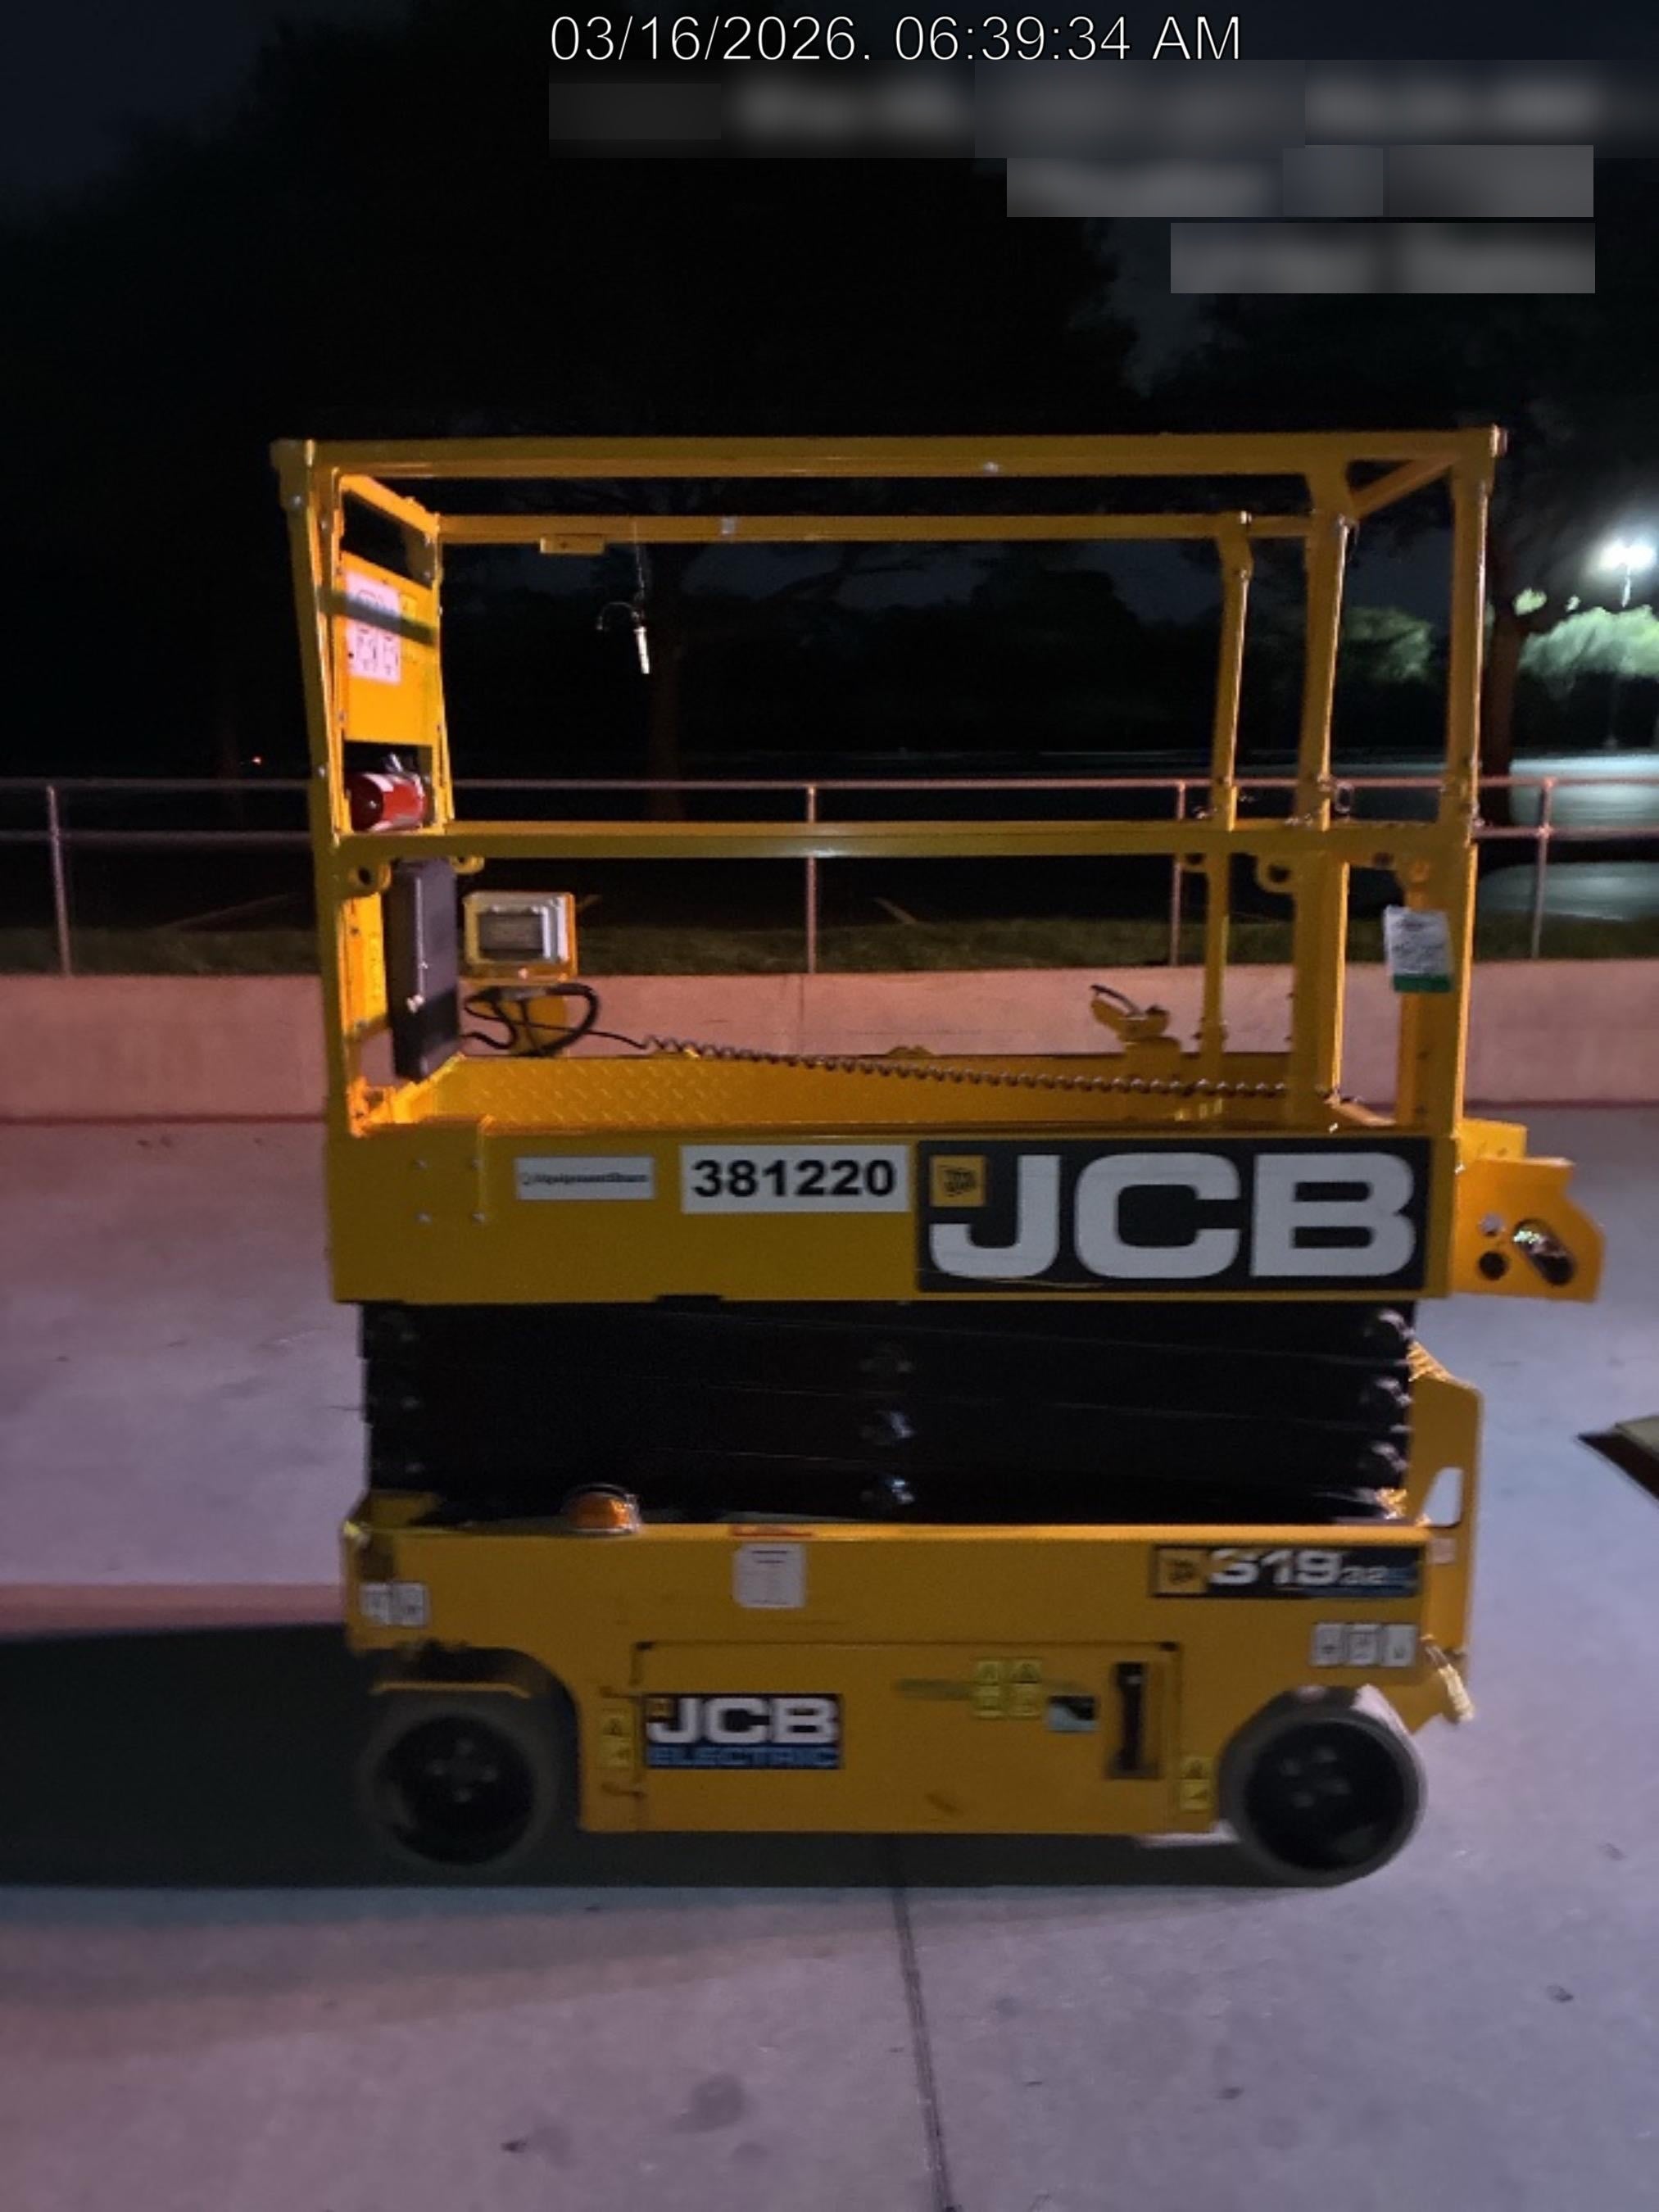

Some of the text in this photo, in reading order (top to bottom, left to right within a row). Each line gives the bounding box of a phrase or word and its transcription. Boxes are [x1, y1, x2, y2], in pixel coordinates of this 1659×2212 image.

[693, 1158, 895, 1197] 381220
[929, 1152, 1416, 1279] JCB
[646, 1698, 838, 1743] JCB
